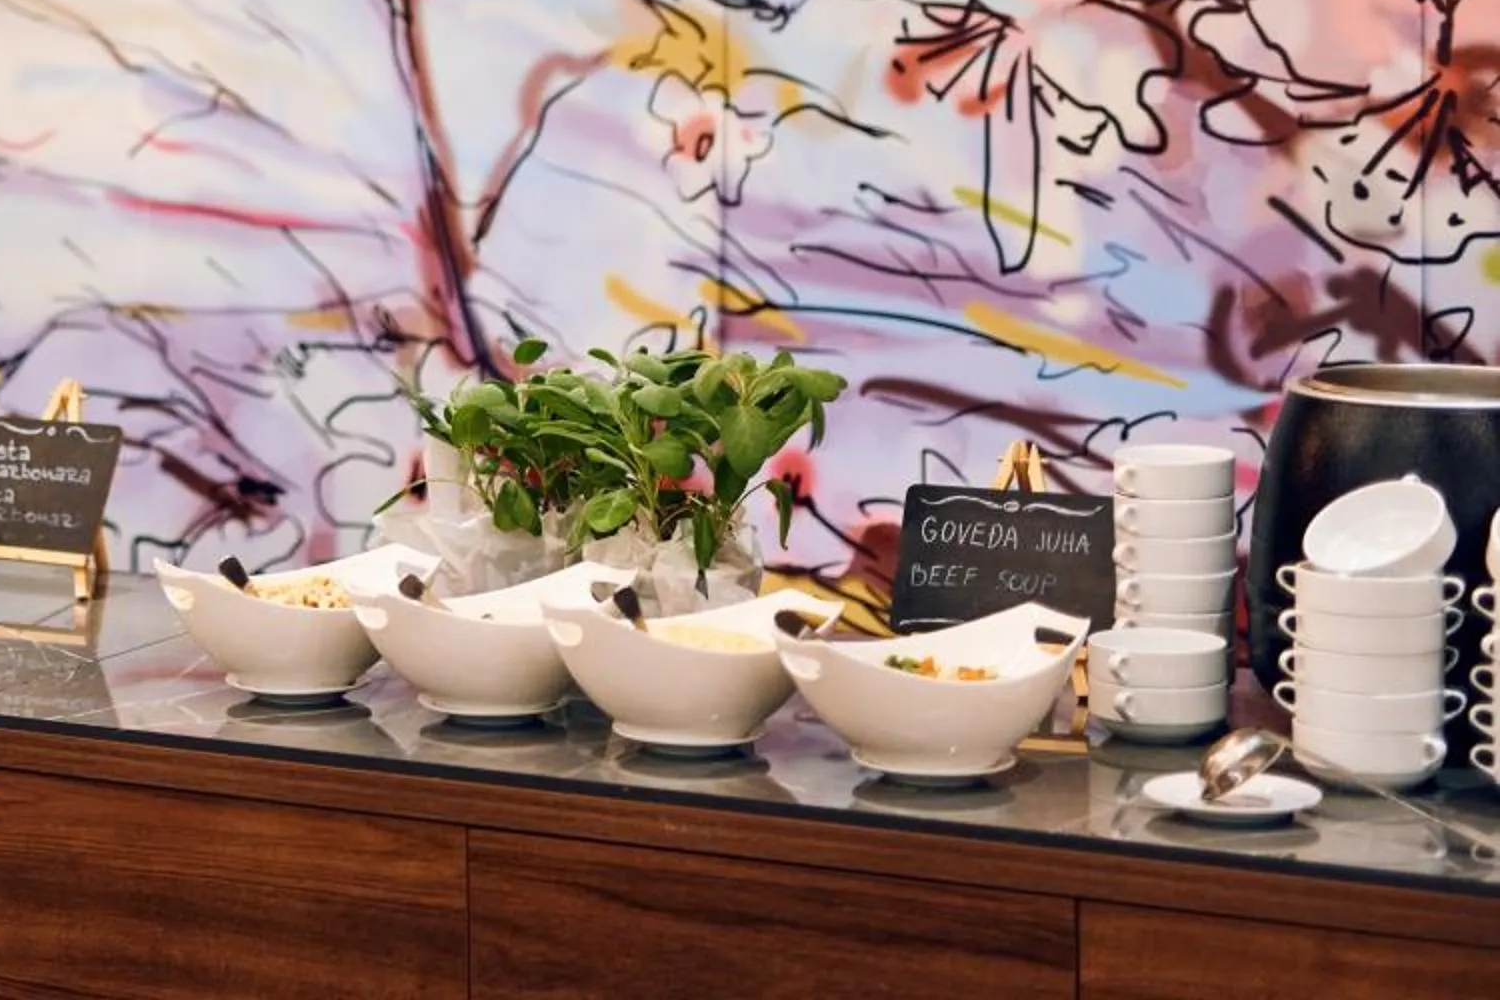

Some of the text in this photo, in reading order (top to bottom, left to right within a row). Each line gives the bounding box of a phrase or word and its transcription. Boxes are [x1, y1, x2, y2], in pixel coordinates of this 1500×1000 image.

[921, 516, 1091, 555] GOVEDA JUHA
[910, 562, 1058, 595] BEEF SOUP
